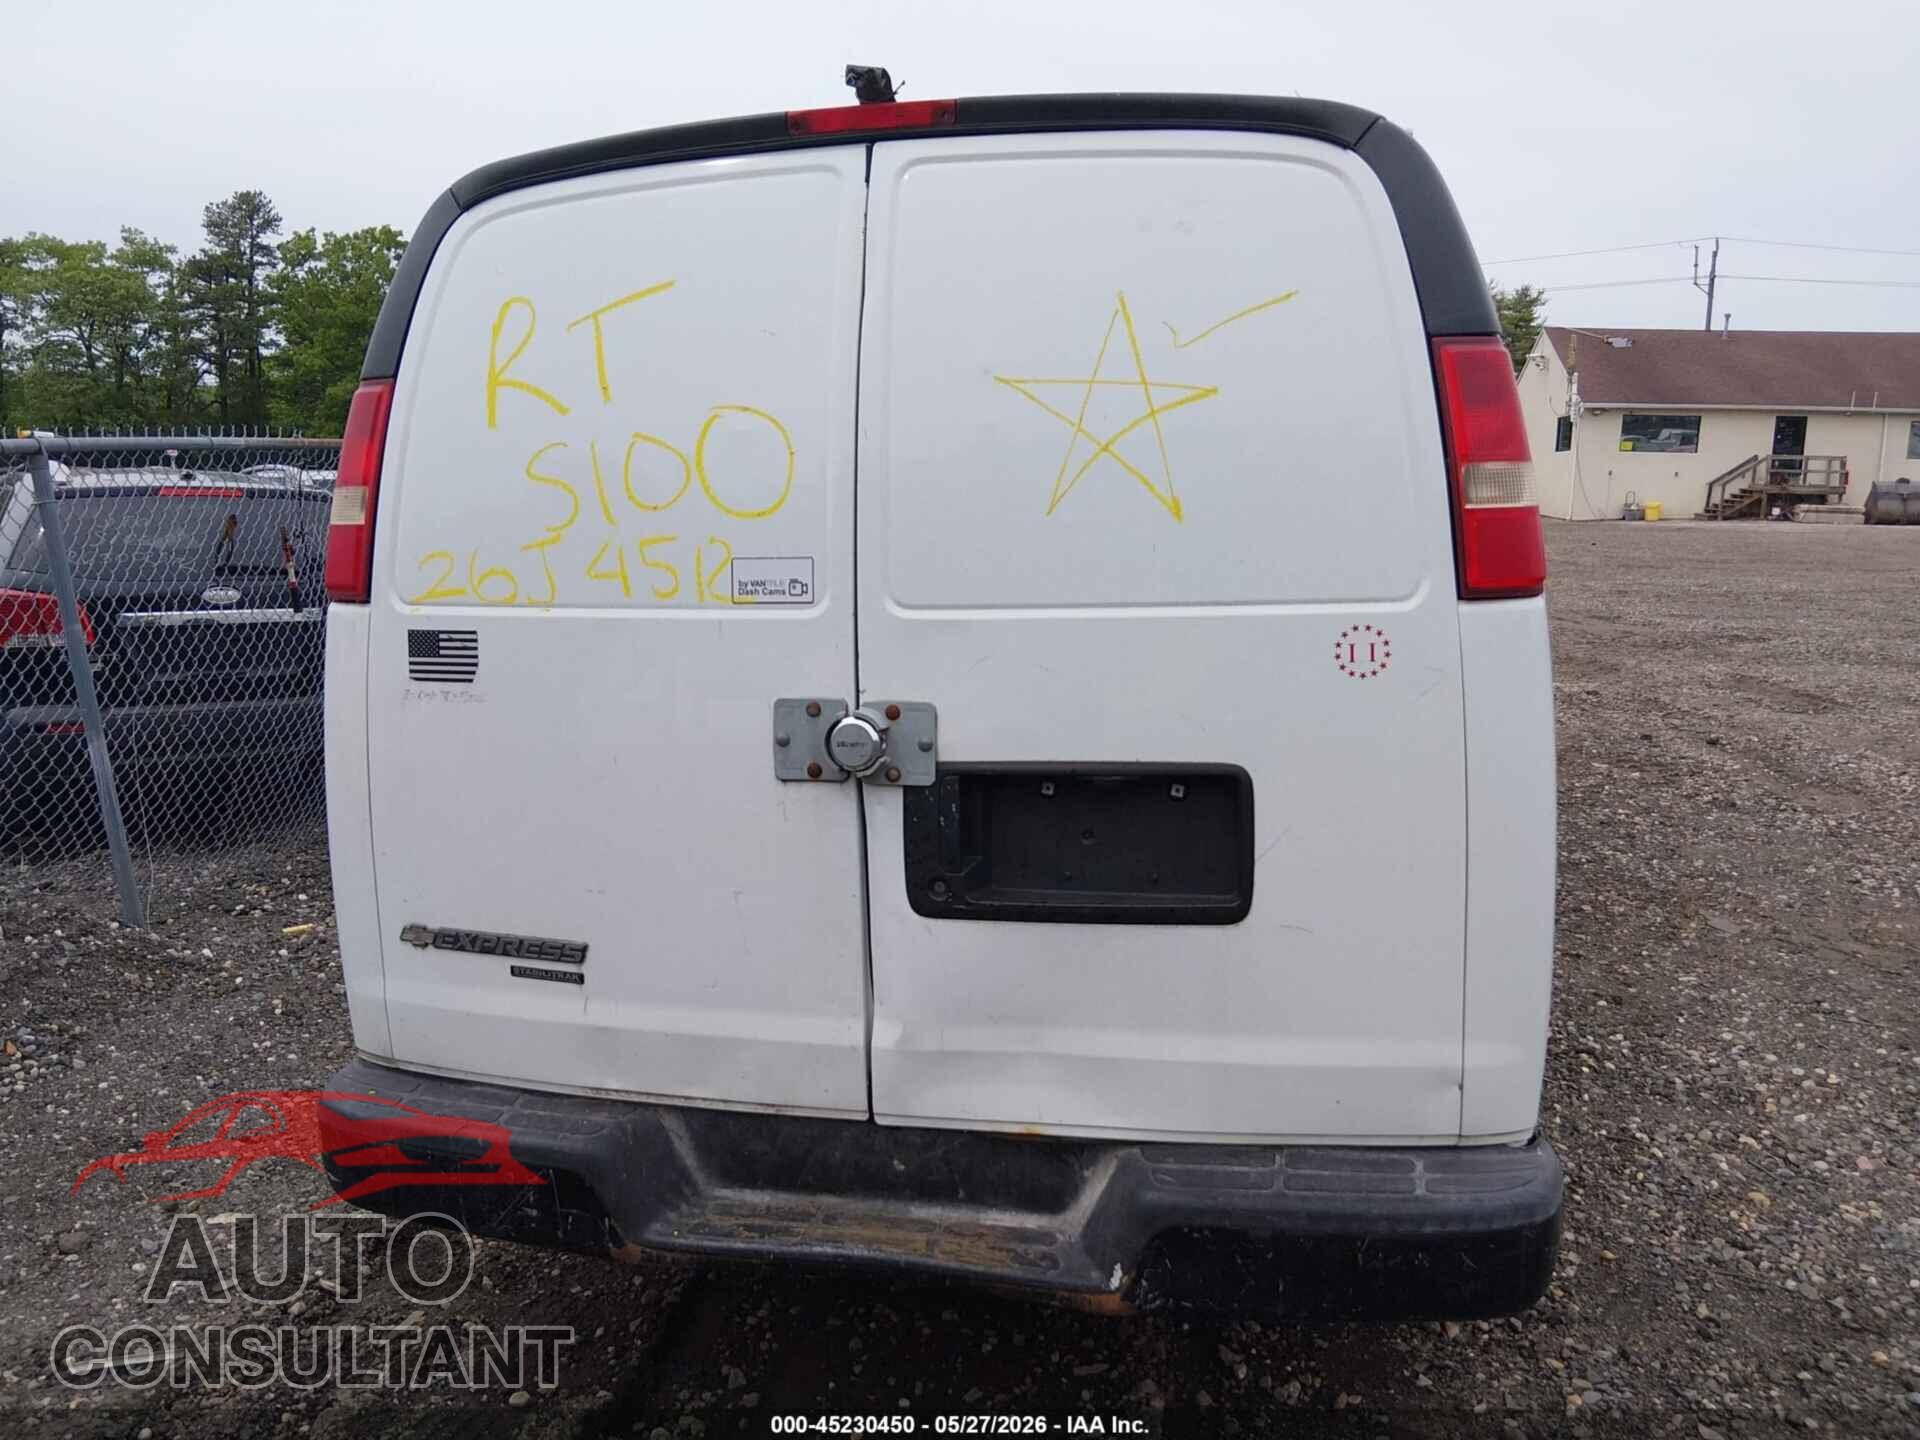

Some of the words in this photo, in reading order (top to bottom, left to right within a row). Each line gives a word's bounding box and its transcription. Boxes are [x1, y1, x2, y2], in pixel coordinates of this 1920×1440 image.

[484, 280, 676, 430] RT
[738, 587, 761, 596] Dash
[762, 587, 786, 596] Cams
[433, 928, 588, 964] EXPRESS
